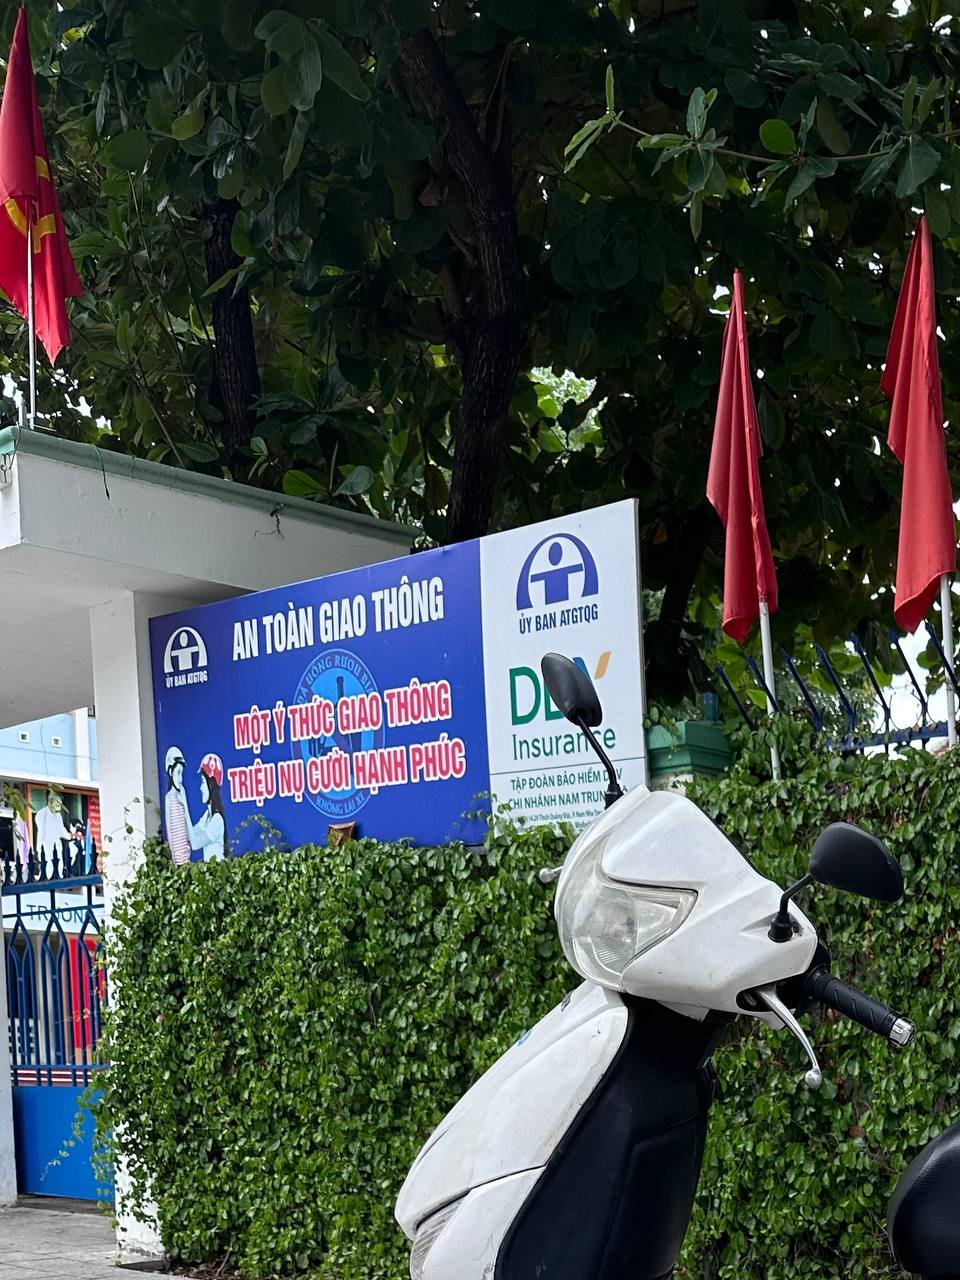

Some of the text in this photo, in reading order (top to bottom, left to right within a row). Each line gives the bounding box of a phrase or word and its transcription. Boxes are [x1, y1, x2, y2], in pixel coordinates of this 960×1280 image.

[233, 575, 445, 661] AN TOÀN GIAO THÔNG
[518, 603, 599, 634] ỦY BAN ATGTQG
[174, 673, 187, 687] BAN
[234, 678, 452, 753] MỘT Ý THỨC GIAO THÔNG
[229, 733, 466, 806] TRIỆU NỤ CƯỜI HẠNH PHÚC
[510, 767, 623, 793] TẬP ĐOÀN BẢO HIỂM DV
[524, 793, 557, 809] NHÁNH
[559, 792, 580, 806] NAM
[581, 790, 607, 804] TRUN
